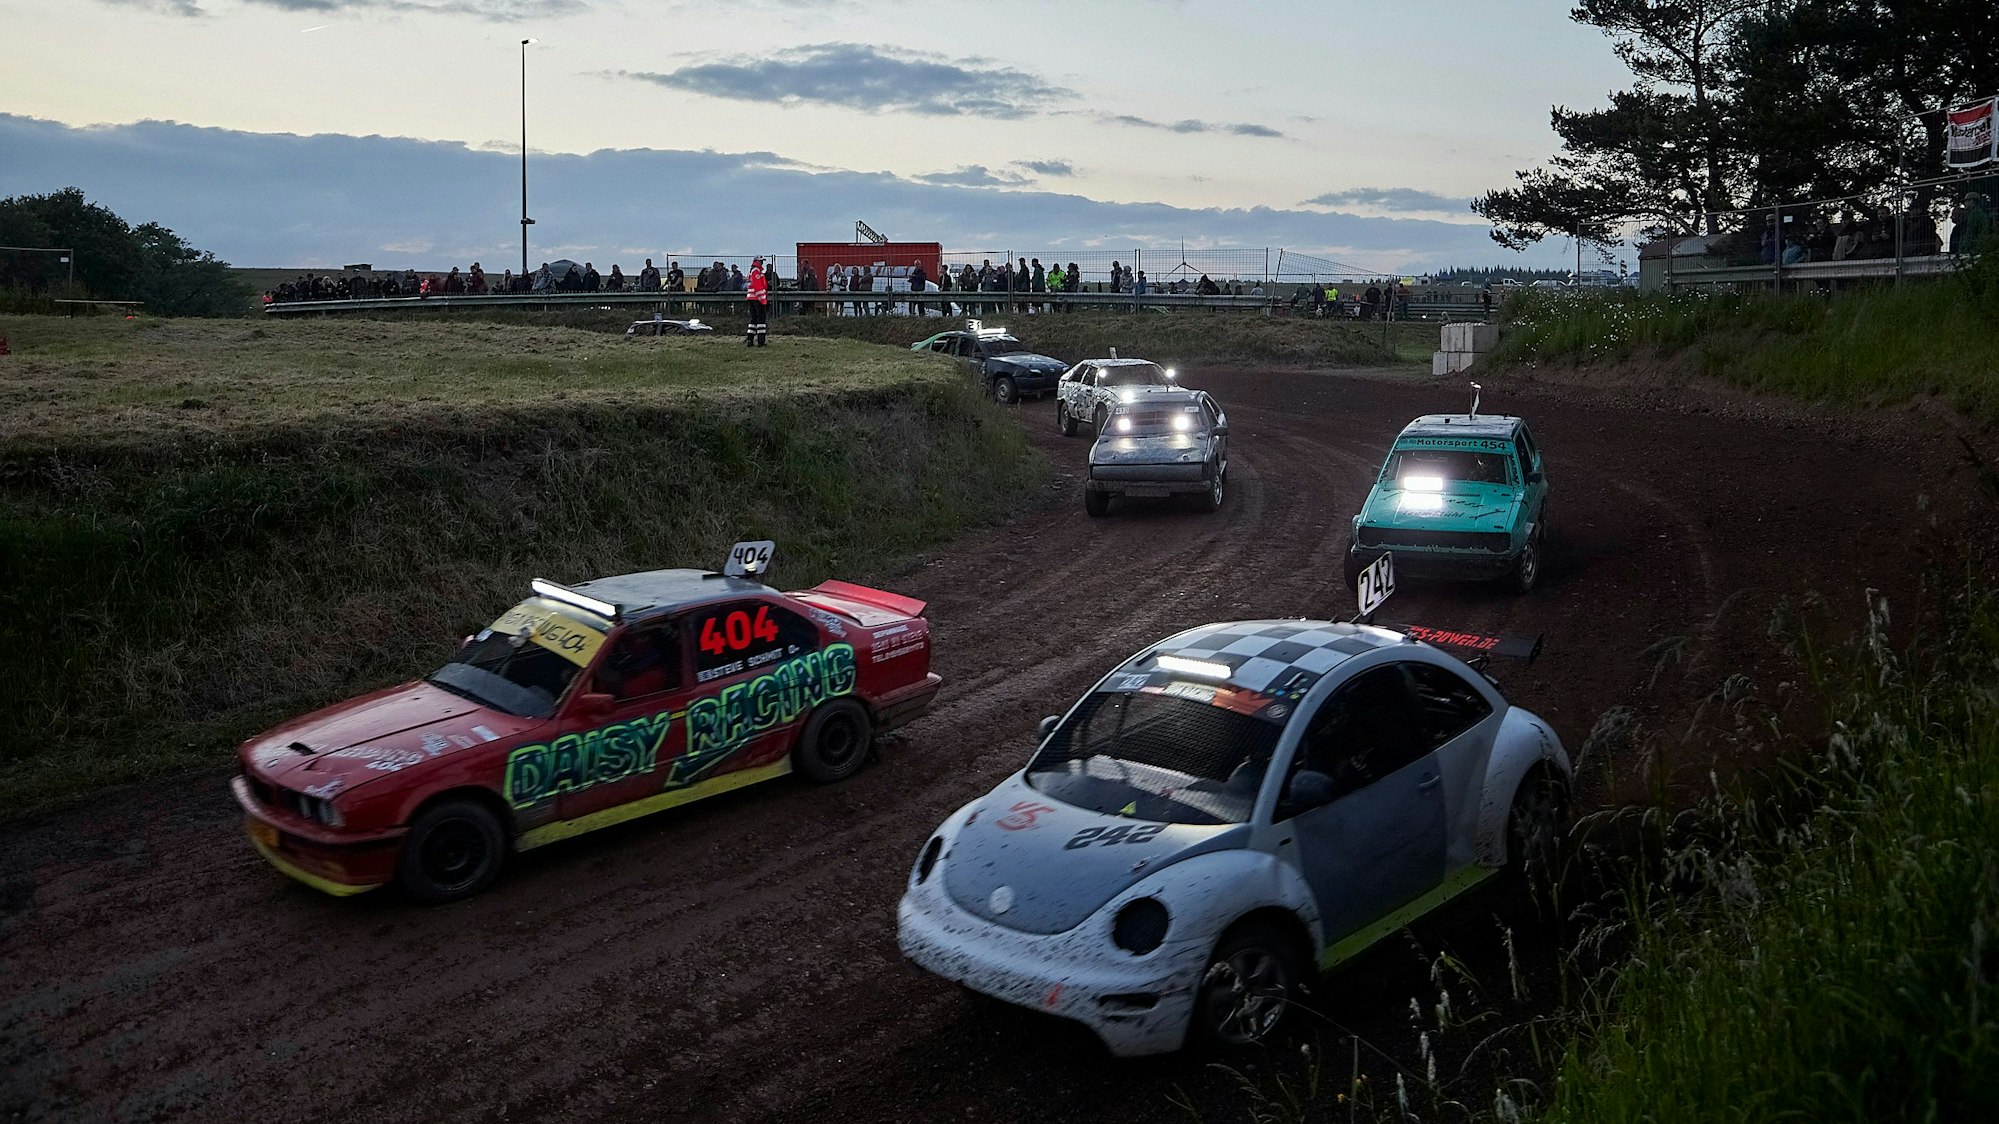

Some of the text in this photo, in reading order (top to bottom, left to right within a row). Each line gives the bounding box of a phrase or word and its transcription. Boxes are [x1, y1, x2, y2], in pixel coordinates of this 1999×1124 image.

[1416, 437, 1507, 451] Motorsport 454
[733, 546, 769, 565] 404
[1361, 557, 1394, 609] 242
[699, 606, 779, 655] 404
[503, 642, 857, 810] DAISY RACING
[1063, 823, 1166, 850] 242
